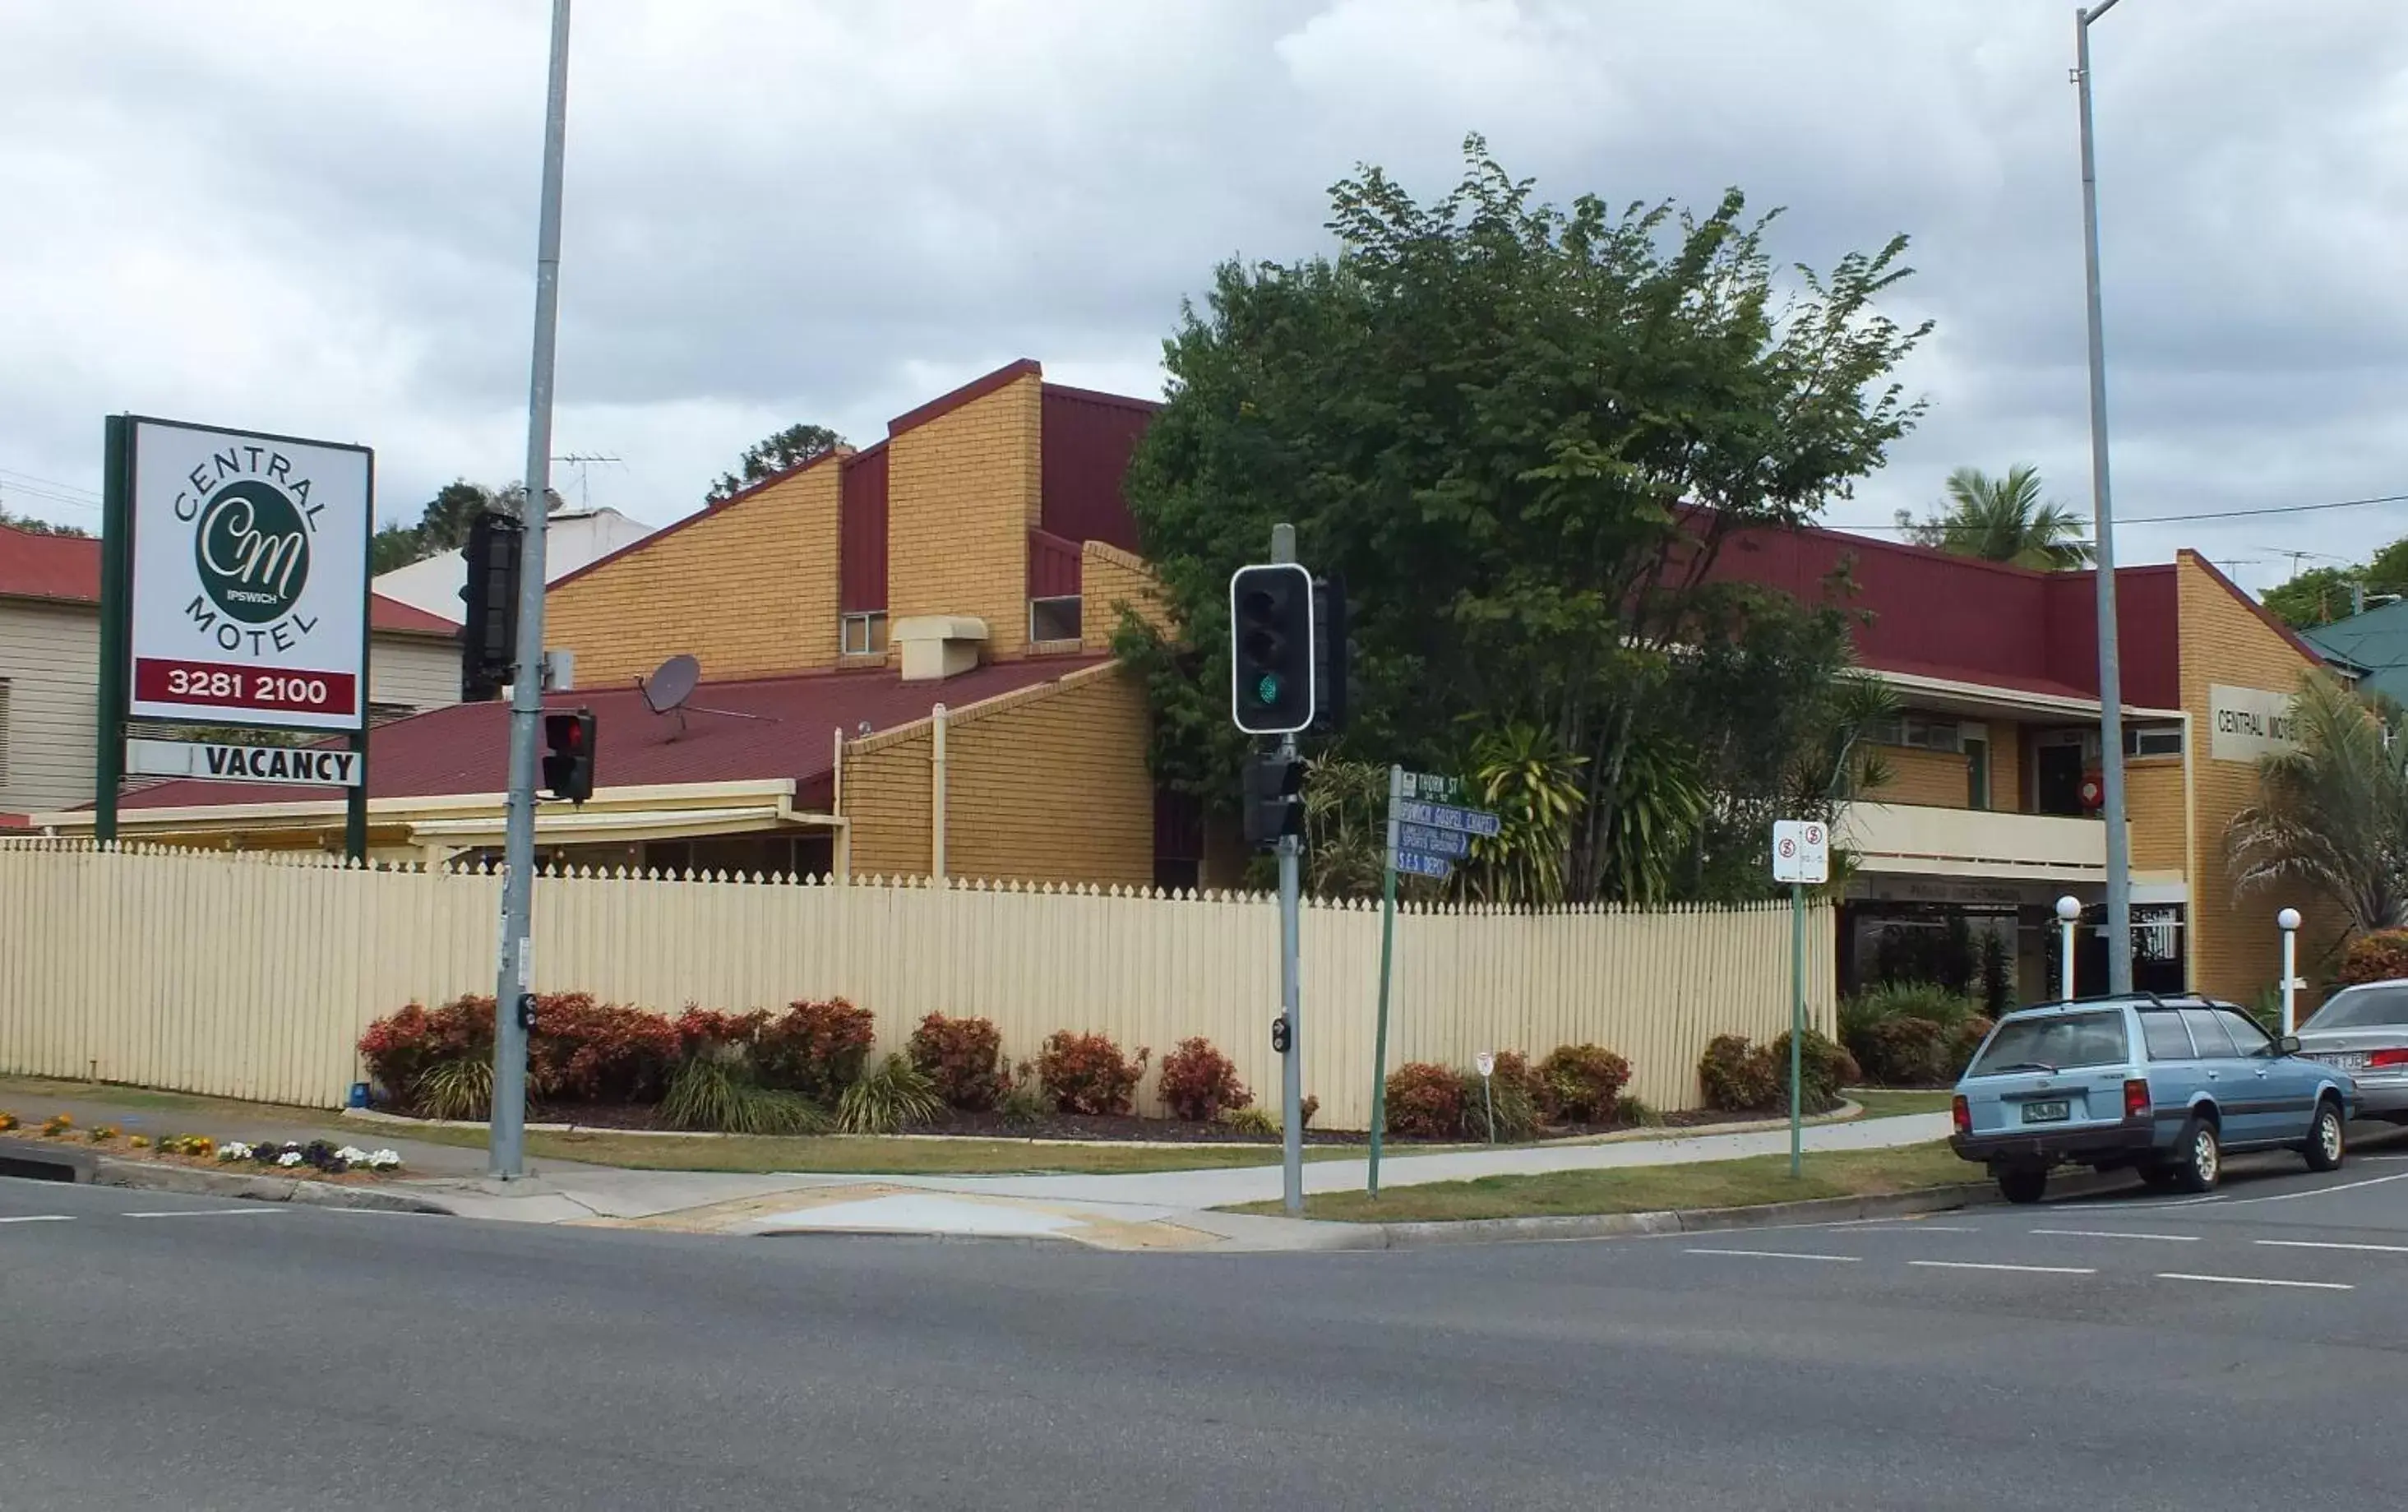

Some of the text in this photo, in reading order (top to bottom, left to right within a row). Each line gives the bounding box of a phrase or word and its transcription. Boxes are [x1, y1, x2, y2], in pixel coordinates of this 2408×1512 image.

[175, 446, 329, 532] CENTRAL
[227, 589, 278, 604] IPSWICH
[184, 594, 318, 656] MOTEL
[168, 669, 327, 705] 3281 2100
[2218, 709, 2263, 737] CENTRAL
[206, 747, 354, 781] VACANCY
[1449, 777, 1458, 794] ST
